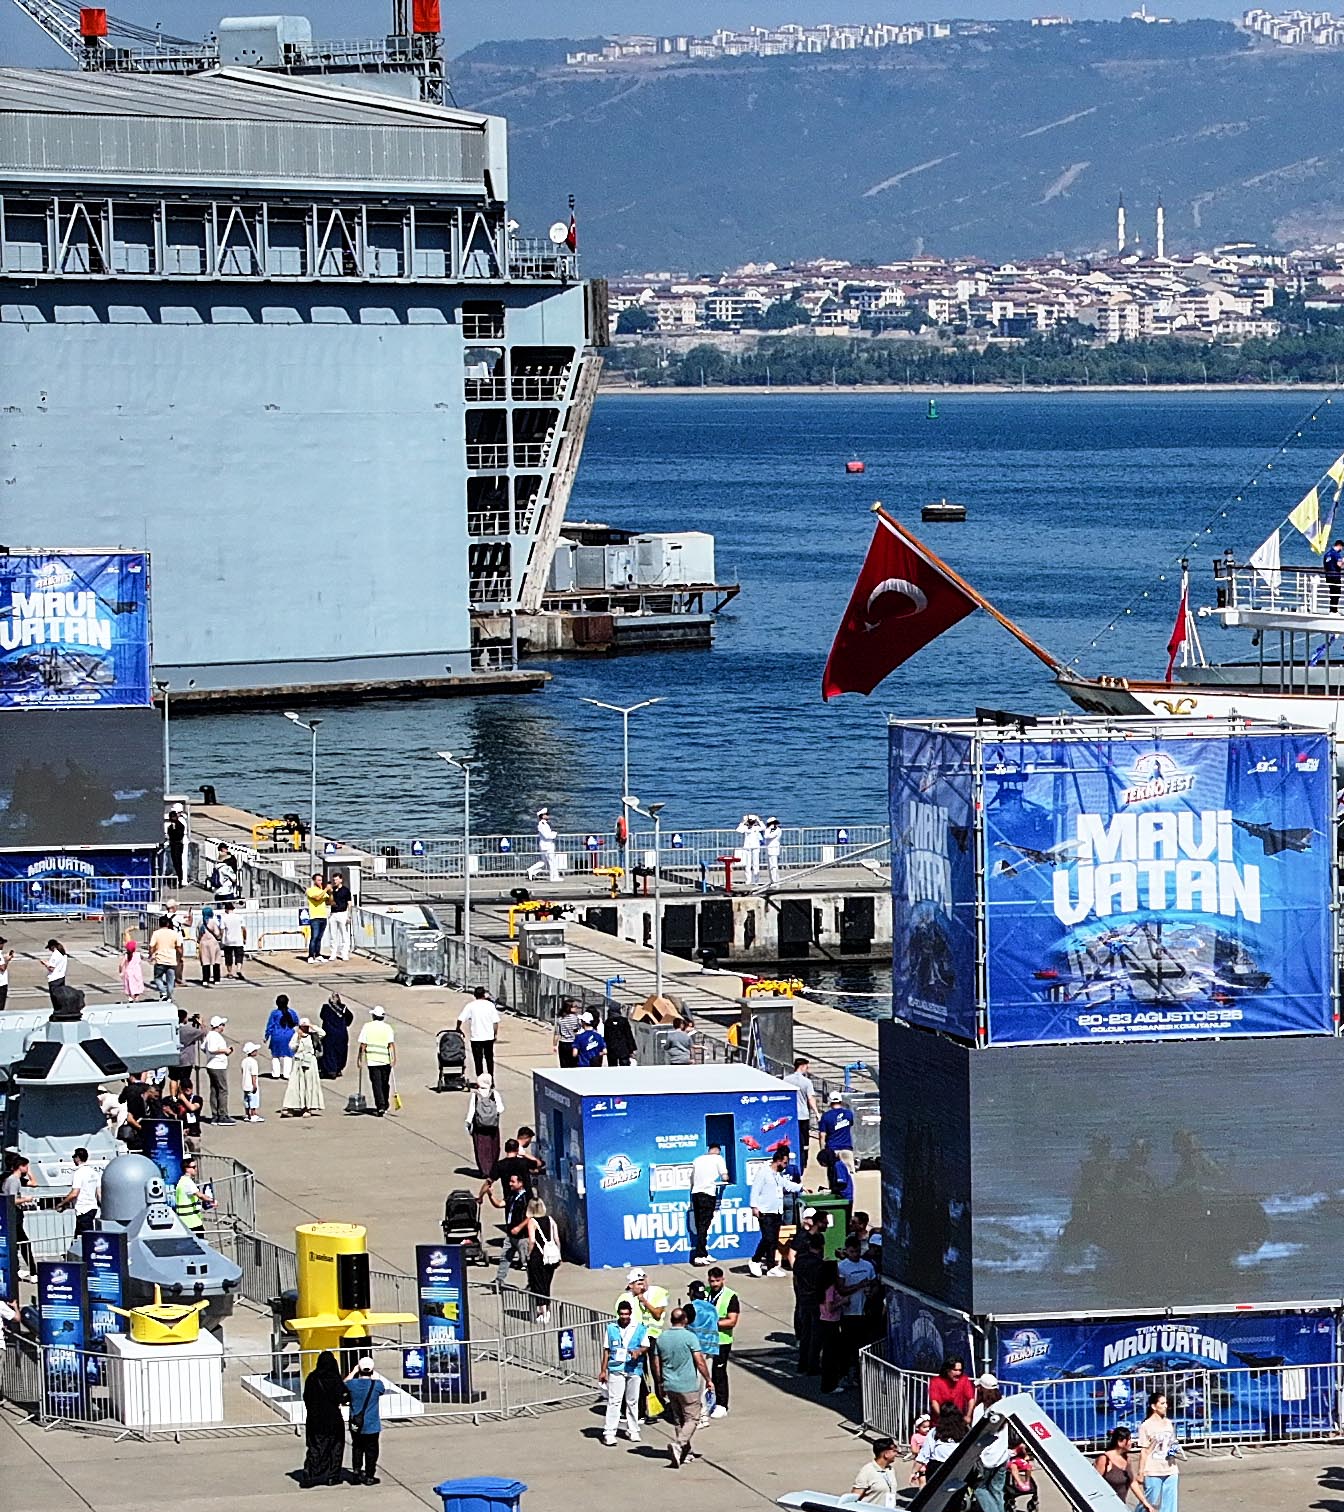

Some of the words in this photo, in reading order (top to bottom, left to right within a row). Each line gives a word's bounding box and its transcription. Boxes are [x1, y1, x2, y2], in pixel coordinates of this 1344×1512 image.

[0, 617, 112, 651] VATAN
[1121, 775, 1196, 804] TEKNOFEST
[1053, 860, 1262, 926] VATAN
[1160, 1331, 1228, 1365] VATAN
